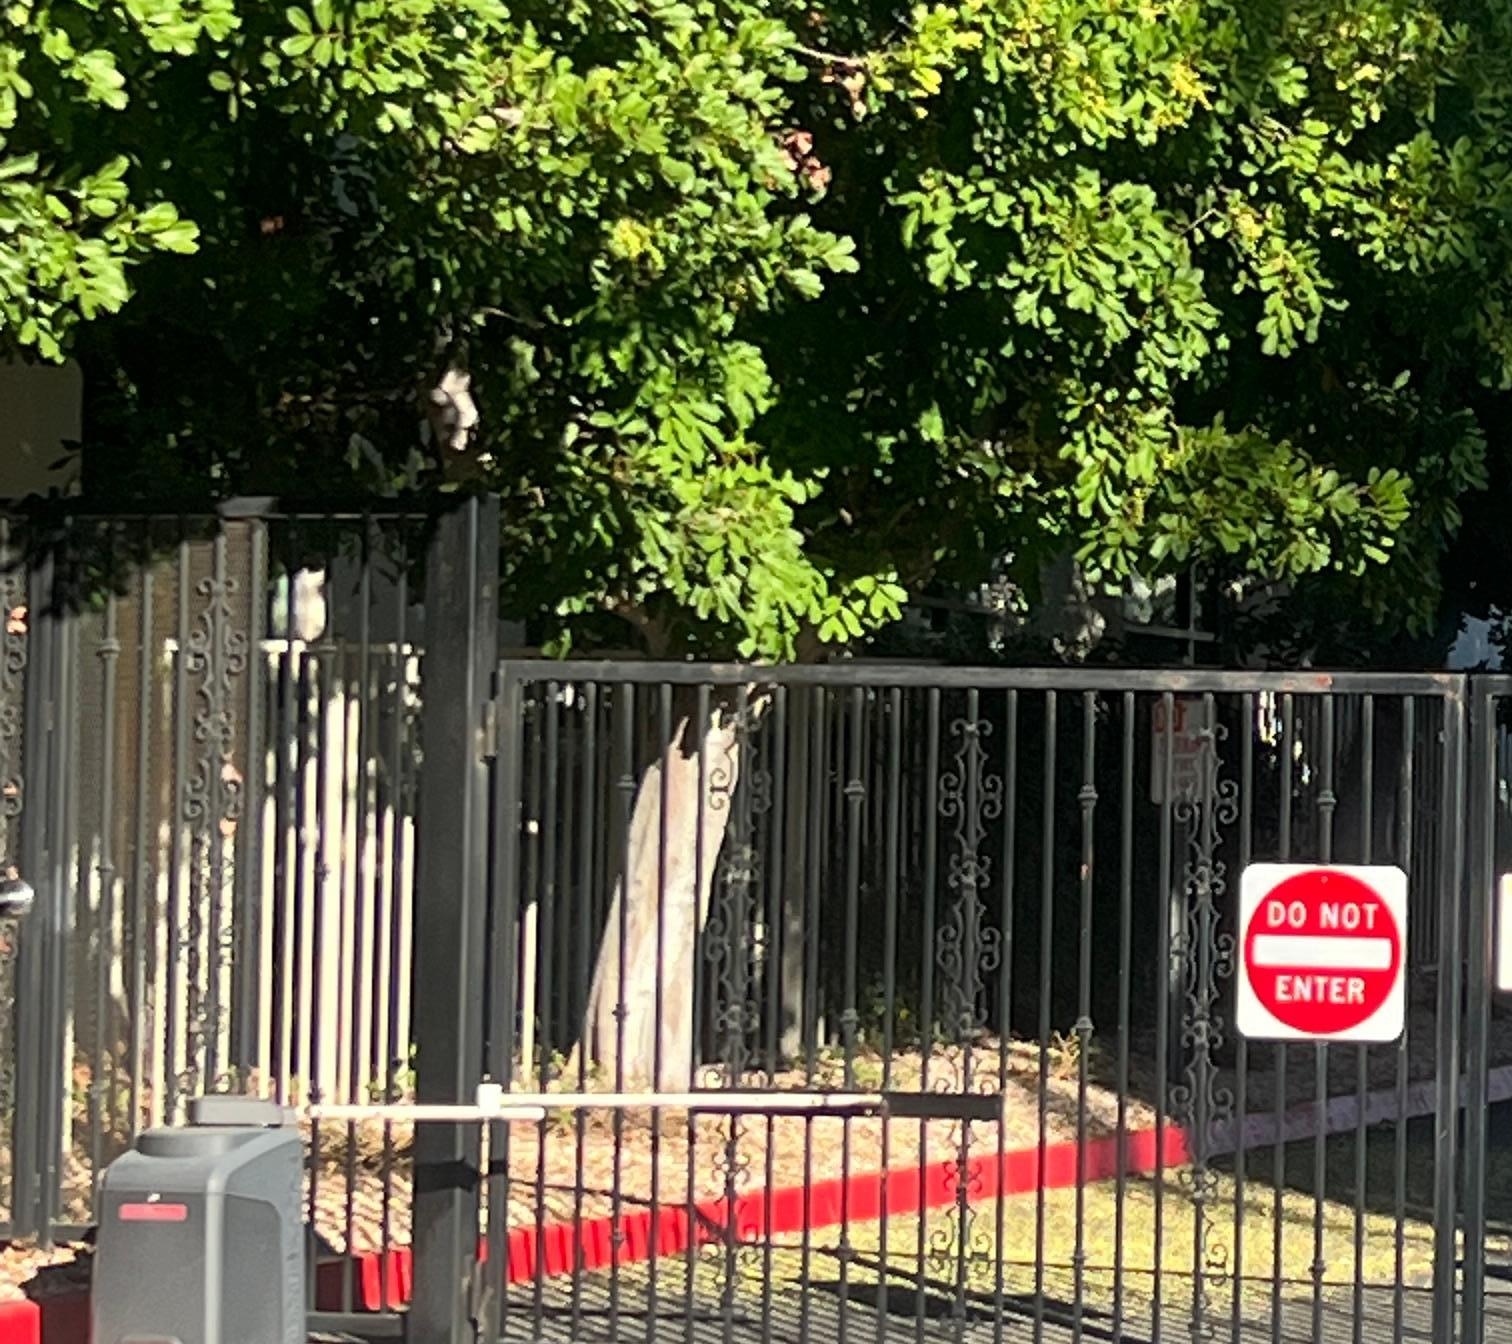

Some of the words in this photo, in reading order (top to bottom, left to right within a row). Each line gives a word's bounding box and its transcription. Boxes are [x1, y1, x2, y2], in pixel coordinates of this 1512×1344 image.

[1266, 899, 1307, 929] DO
[1319, 901, 1379, 931] NOT
[1274, 974, 1366, 1005] ENTER
